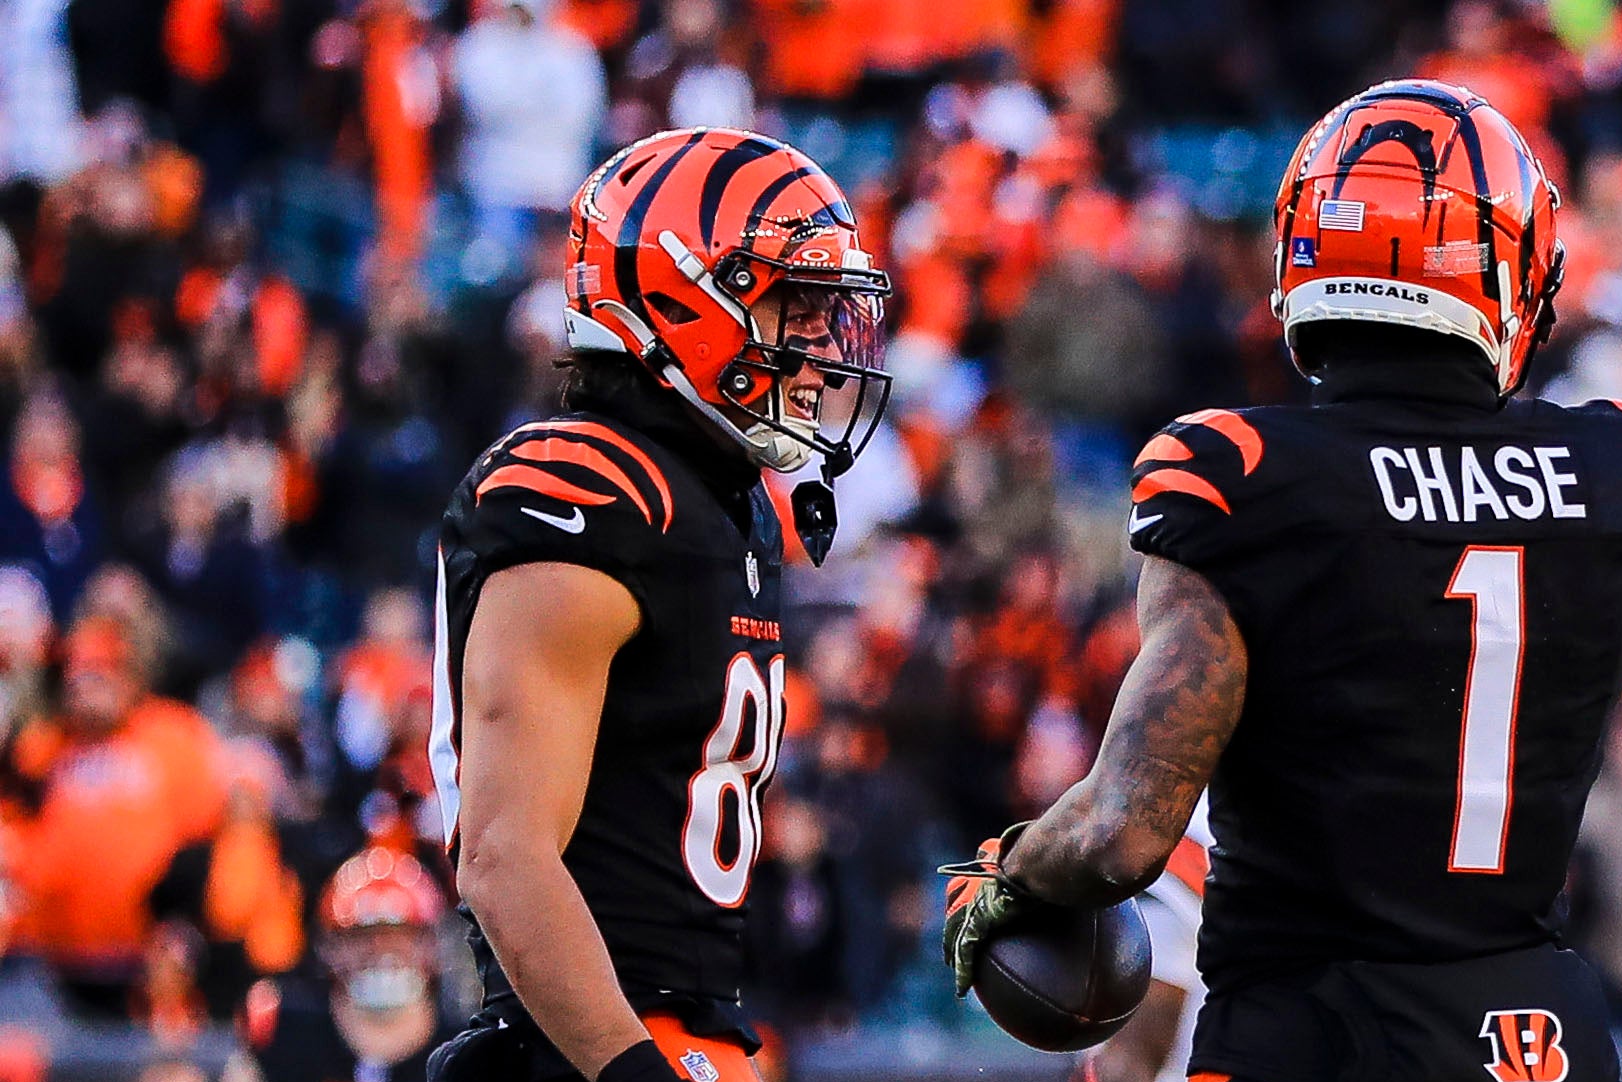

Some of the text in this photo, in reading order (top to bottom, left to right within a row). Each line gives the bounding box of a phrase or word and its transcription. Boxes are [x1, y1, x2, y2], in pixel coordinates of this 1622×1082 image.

[1325, 283, 1429, 304] BENGALS
[1368, 446, 1586, 522] CHASE
[1443, 545, 1525, 874] 1
